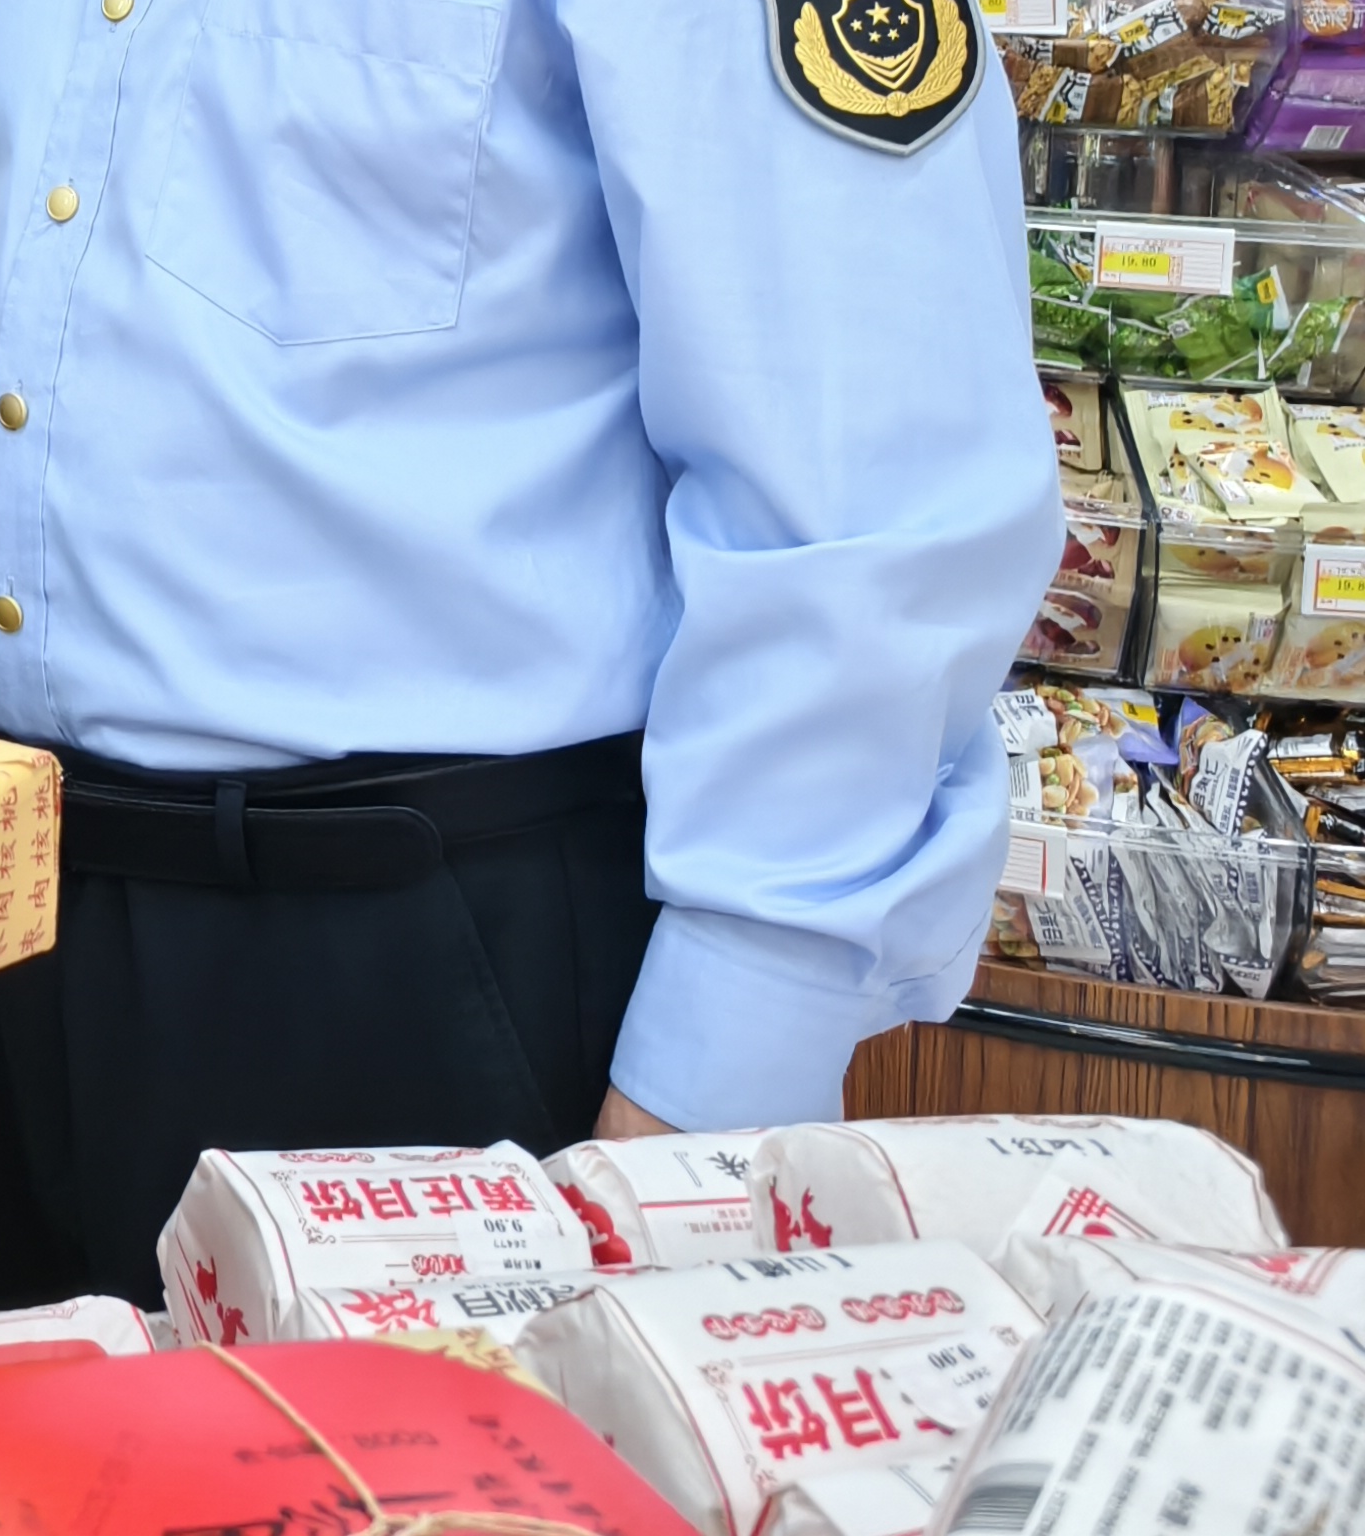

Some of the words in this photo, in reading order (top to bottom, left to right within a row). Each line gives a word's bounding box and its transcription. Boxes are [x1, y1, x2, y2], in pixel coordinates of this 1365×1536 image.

[1338, 579, 1365, 591] 19.8
[300, 1173, 536, 1224] 黄庄月饼
[483, 1218, 524, 1234] 9.90
[741, 1366, 901, 1461] 月饼
